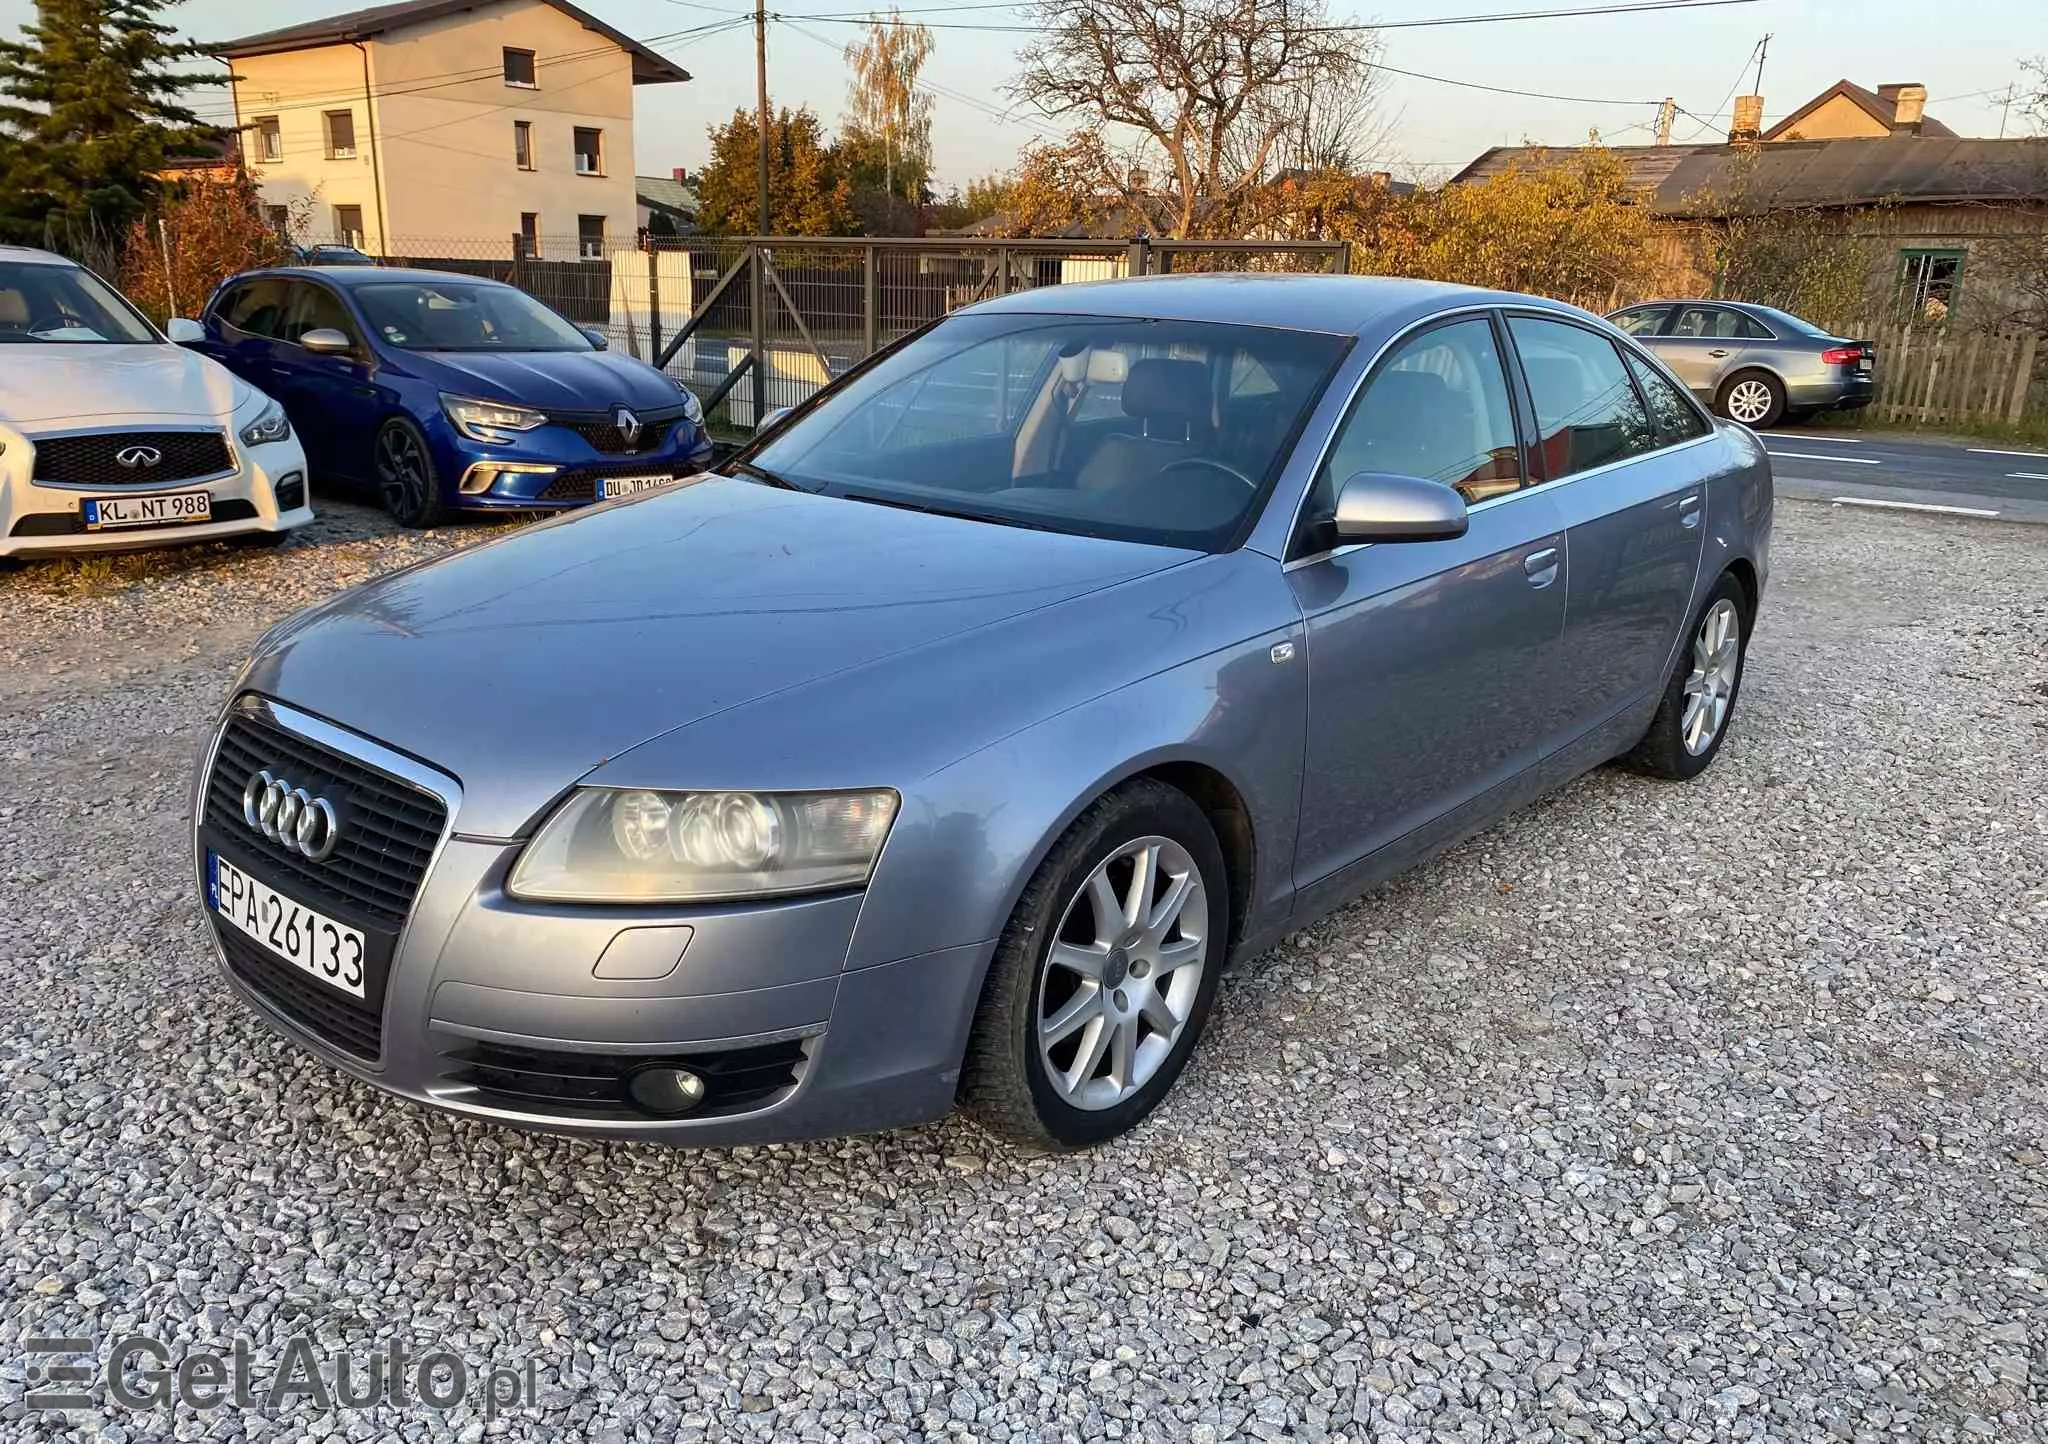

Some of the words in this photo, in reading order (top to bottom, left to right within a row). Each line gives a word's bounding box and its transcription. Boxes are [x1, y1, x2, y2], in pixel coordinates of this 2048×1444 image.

[606, 481, 621, 496] DU
[100, 503, 127, 520] KL
[141, 500, 166, 518] NT
[172, 496, 207, 515] 988
[219, 860, 260, 935] EPA
[268, 894, 363, 988] 26133
